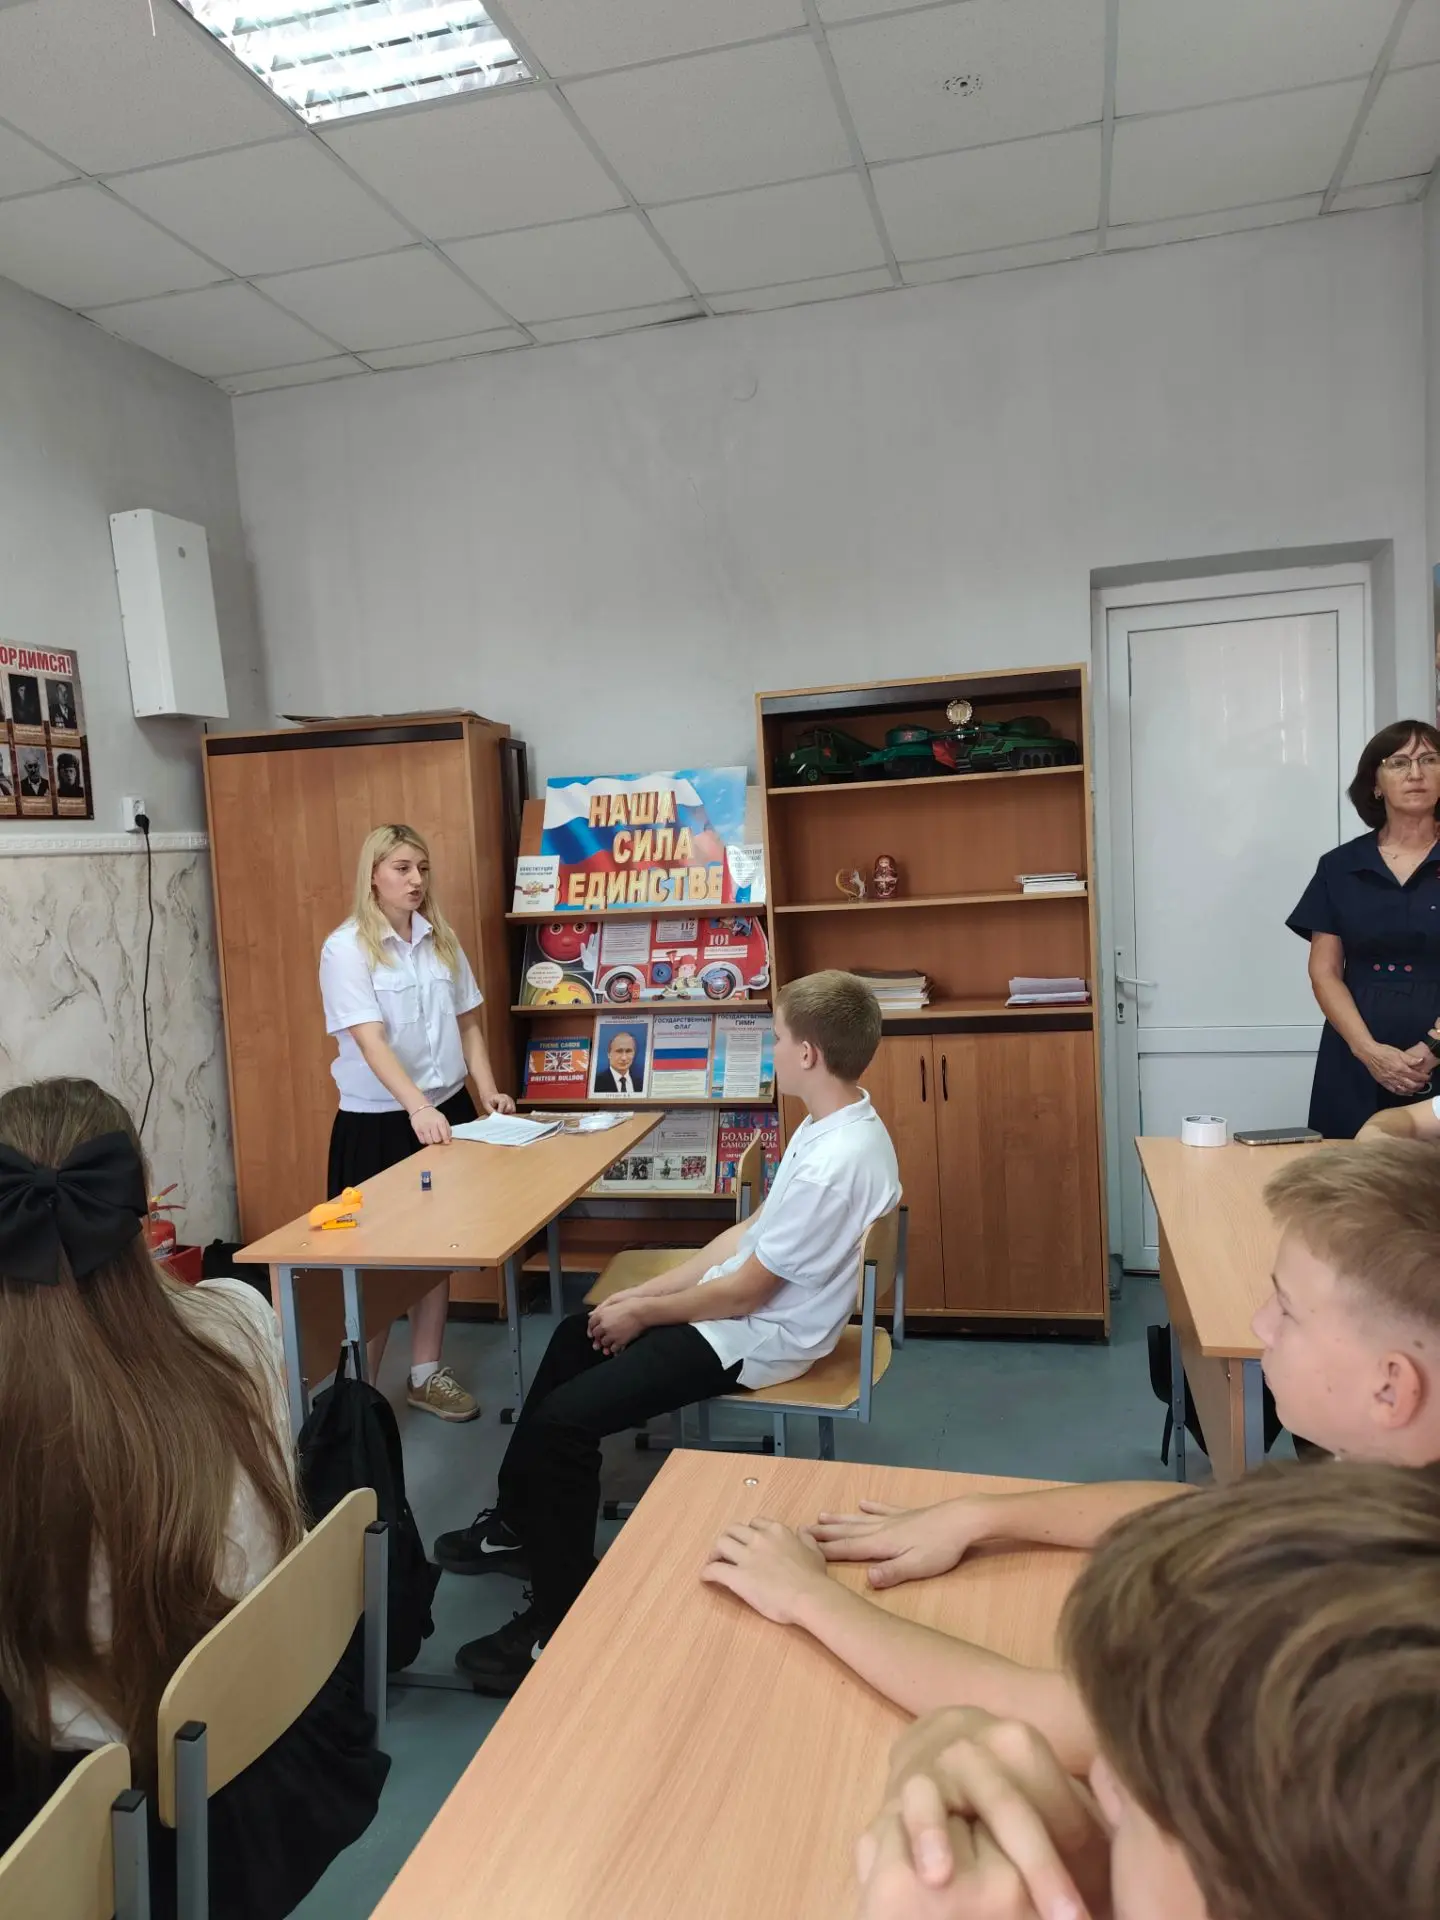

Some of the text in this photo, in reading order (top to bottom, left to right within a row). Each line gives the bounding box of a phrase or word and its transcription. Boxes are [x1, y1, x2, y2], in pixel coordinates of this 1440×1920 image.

[588, 790, 677, 828] НАША
[612, 827, 694, 863] СИЛА
[567, 865, 723, 910] ЕДИНСТВЕ
[680, 922, 695, 931] 112
[709, 934, 729, 945] 101
[721, 1129, 777, 1142] БОЛЬОЙ
